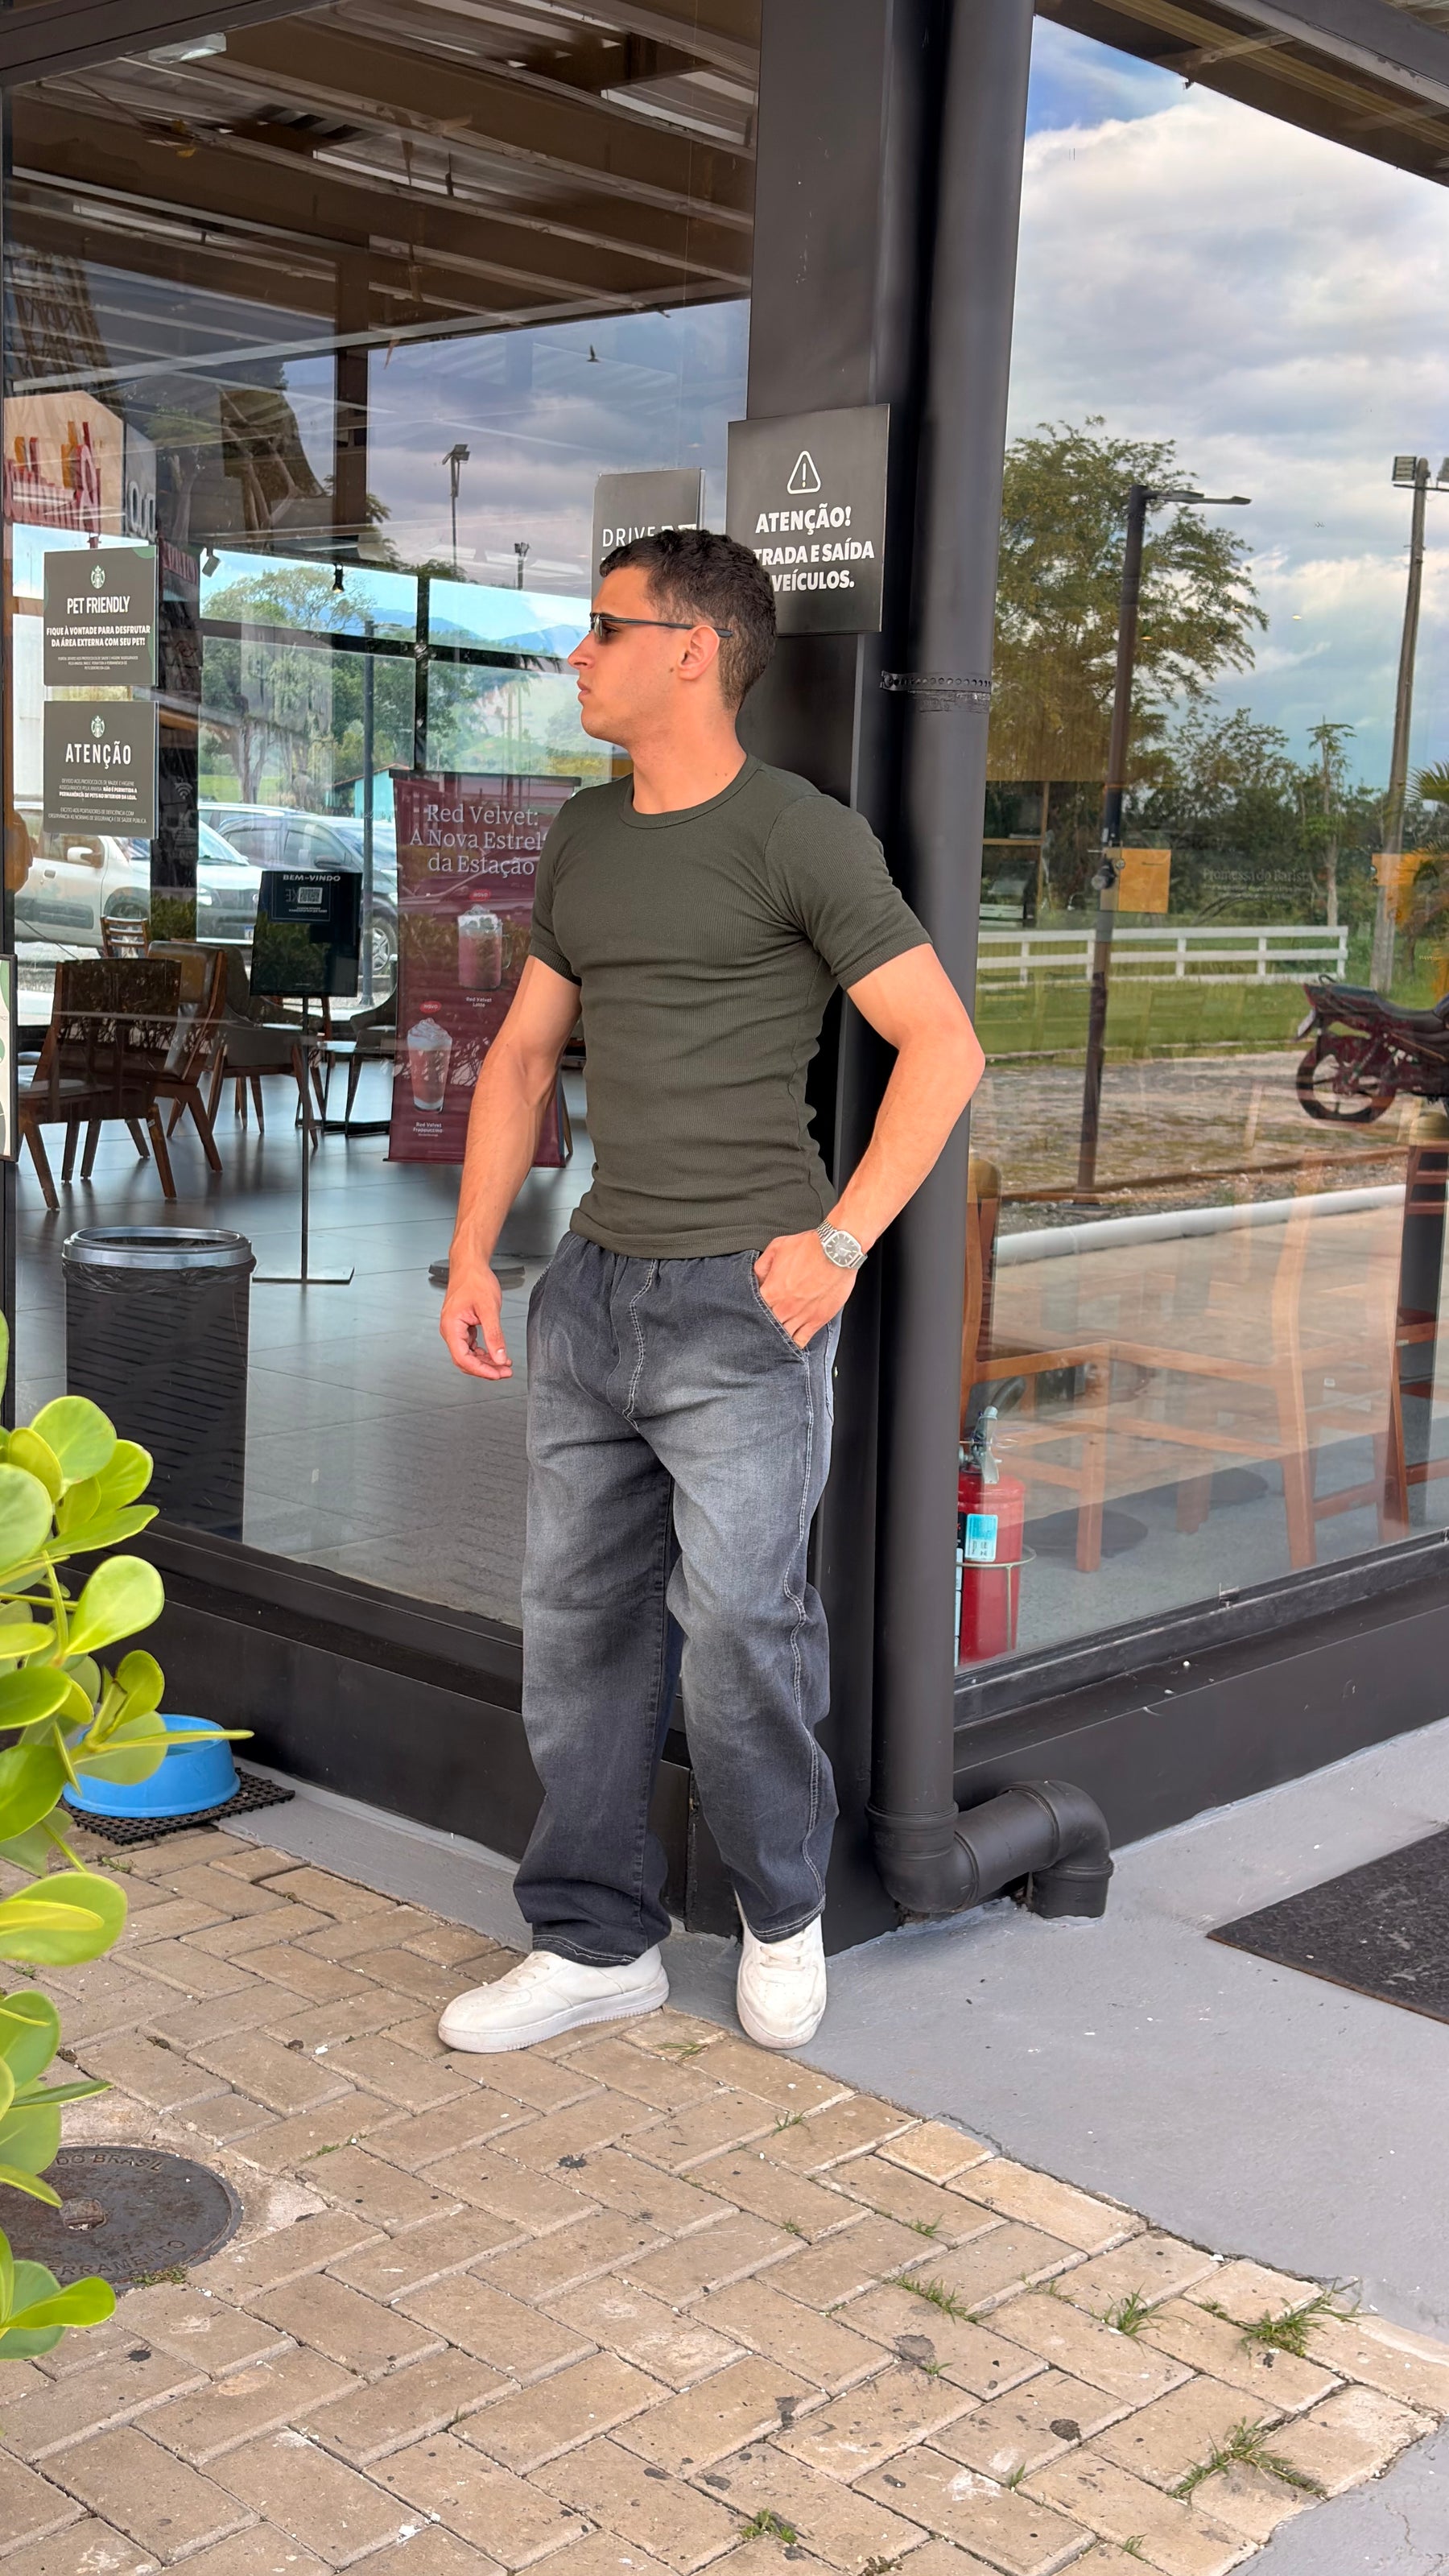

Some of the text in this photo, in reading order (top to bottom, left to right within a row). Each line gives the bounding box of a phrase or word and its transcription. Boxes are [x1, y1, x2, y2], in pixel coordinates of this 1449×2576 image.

[755, 502, 852, 535] ATENÇÃO!
[602, 526, 655, 547] DRIVE
[753, 538, 875, 566] TRADA E SAÍDA
[771, 568, 855, 592] VEÍCULOS.
[67, 596, 130, 614] PET FRIENDLY
[46, 625, 151, 635] FIQUE À VONTADE PARA DESFRUTAR
[51, 637, 146, 647] DA ÁREA EXTERNA COM SEU PET!
[65, 741, 131, 769] ATENÇÃO
[427, 804, 539, 826] Red Velvet:
[410, 828, 547, 851] A Nova Estrel
[427, 852, 535, 878] da Estação
[56, 2154, 163, 2172] DO BRASIL
[48, 2240, 186, 2276] ERRAMENTO
